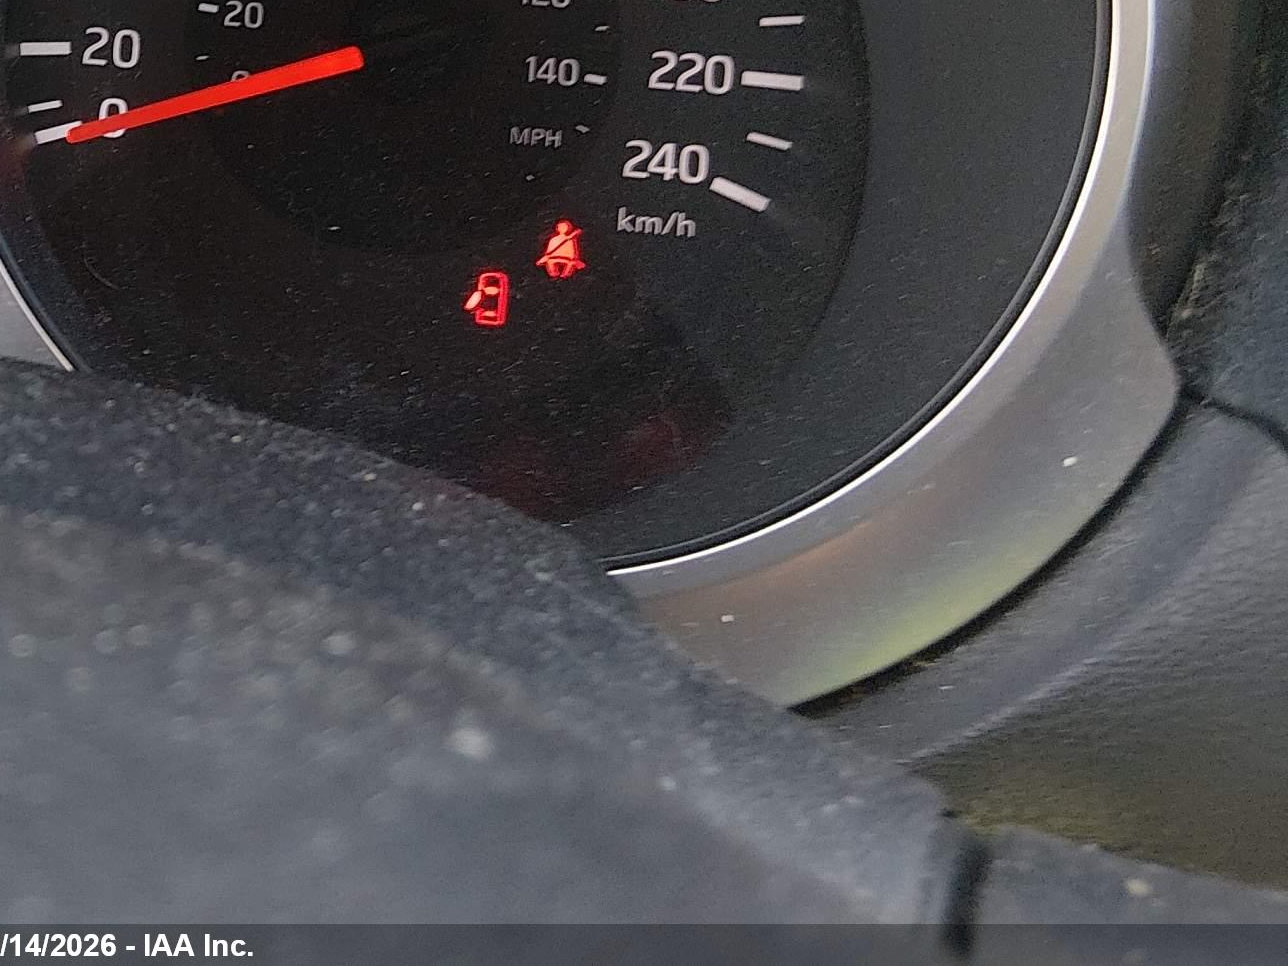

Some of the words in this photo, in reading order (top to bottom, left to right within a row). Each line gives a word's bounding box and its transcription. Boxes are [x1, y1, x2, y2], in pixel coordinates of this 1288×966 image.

[223, 0, 264, 29] 20
[82, 26, 141, 69] 20
[525, 56, 579, 86] 140
[648, 50, 735, 95] 220
[509, 126, 562, 148] MPH
[622, 139, 710, 184] 240
[617, 206, 696, 238] km/h
